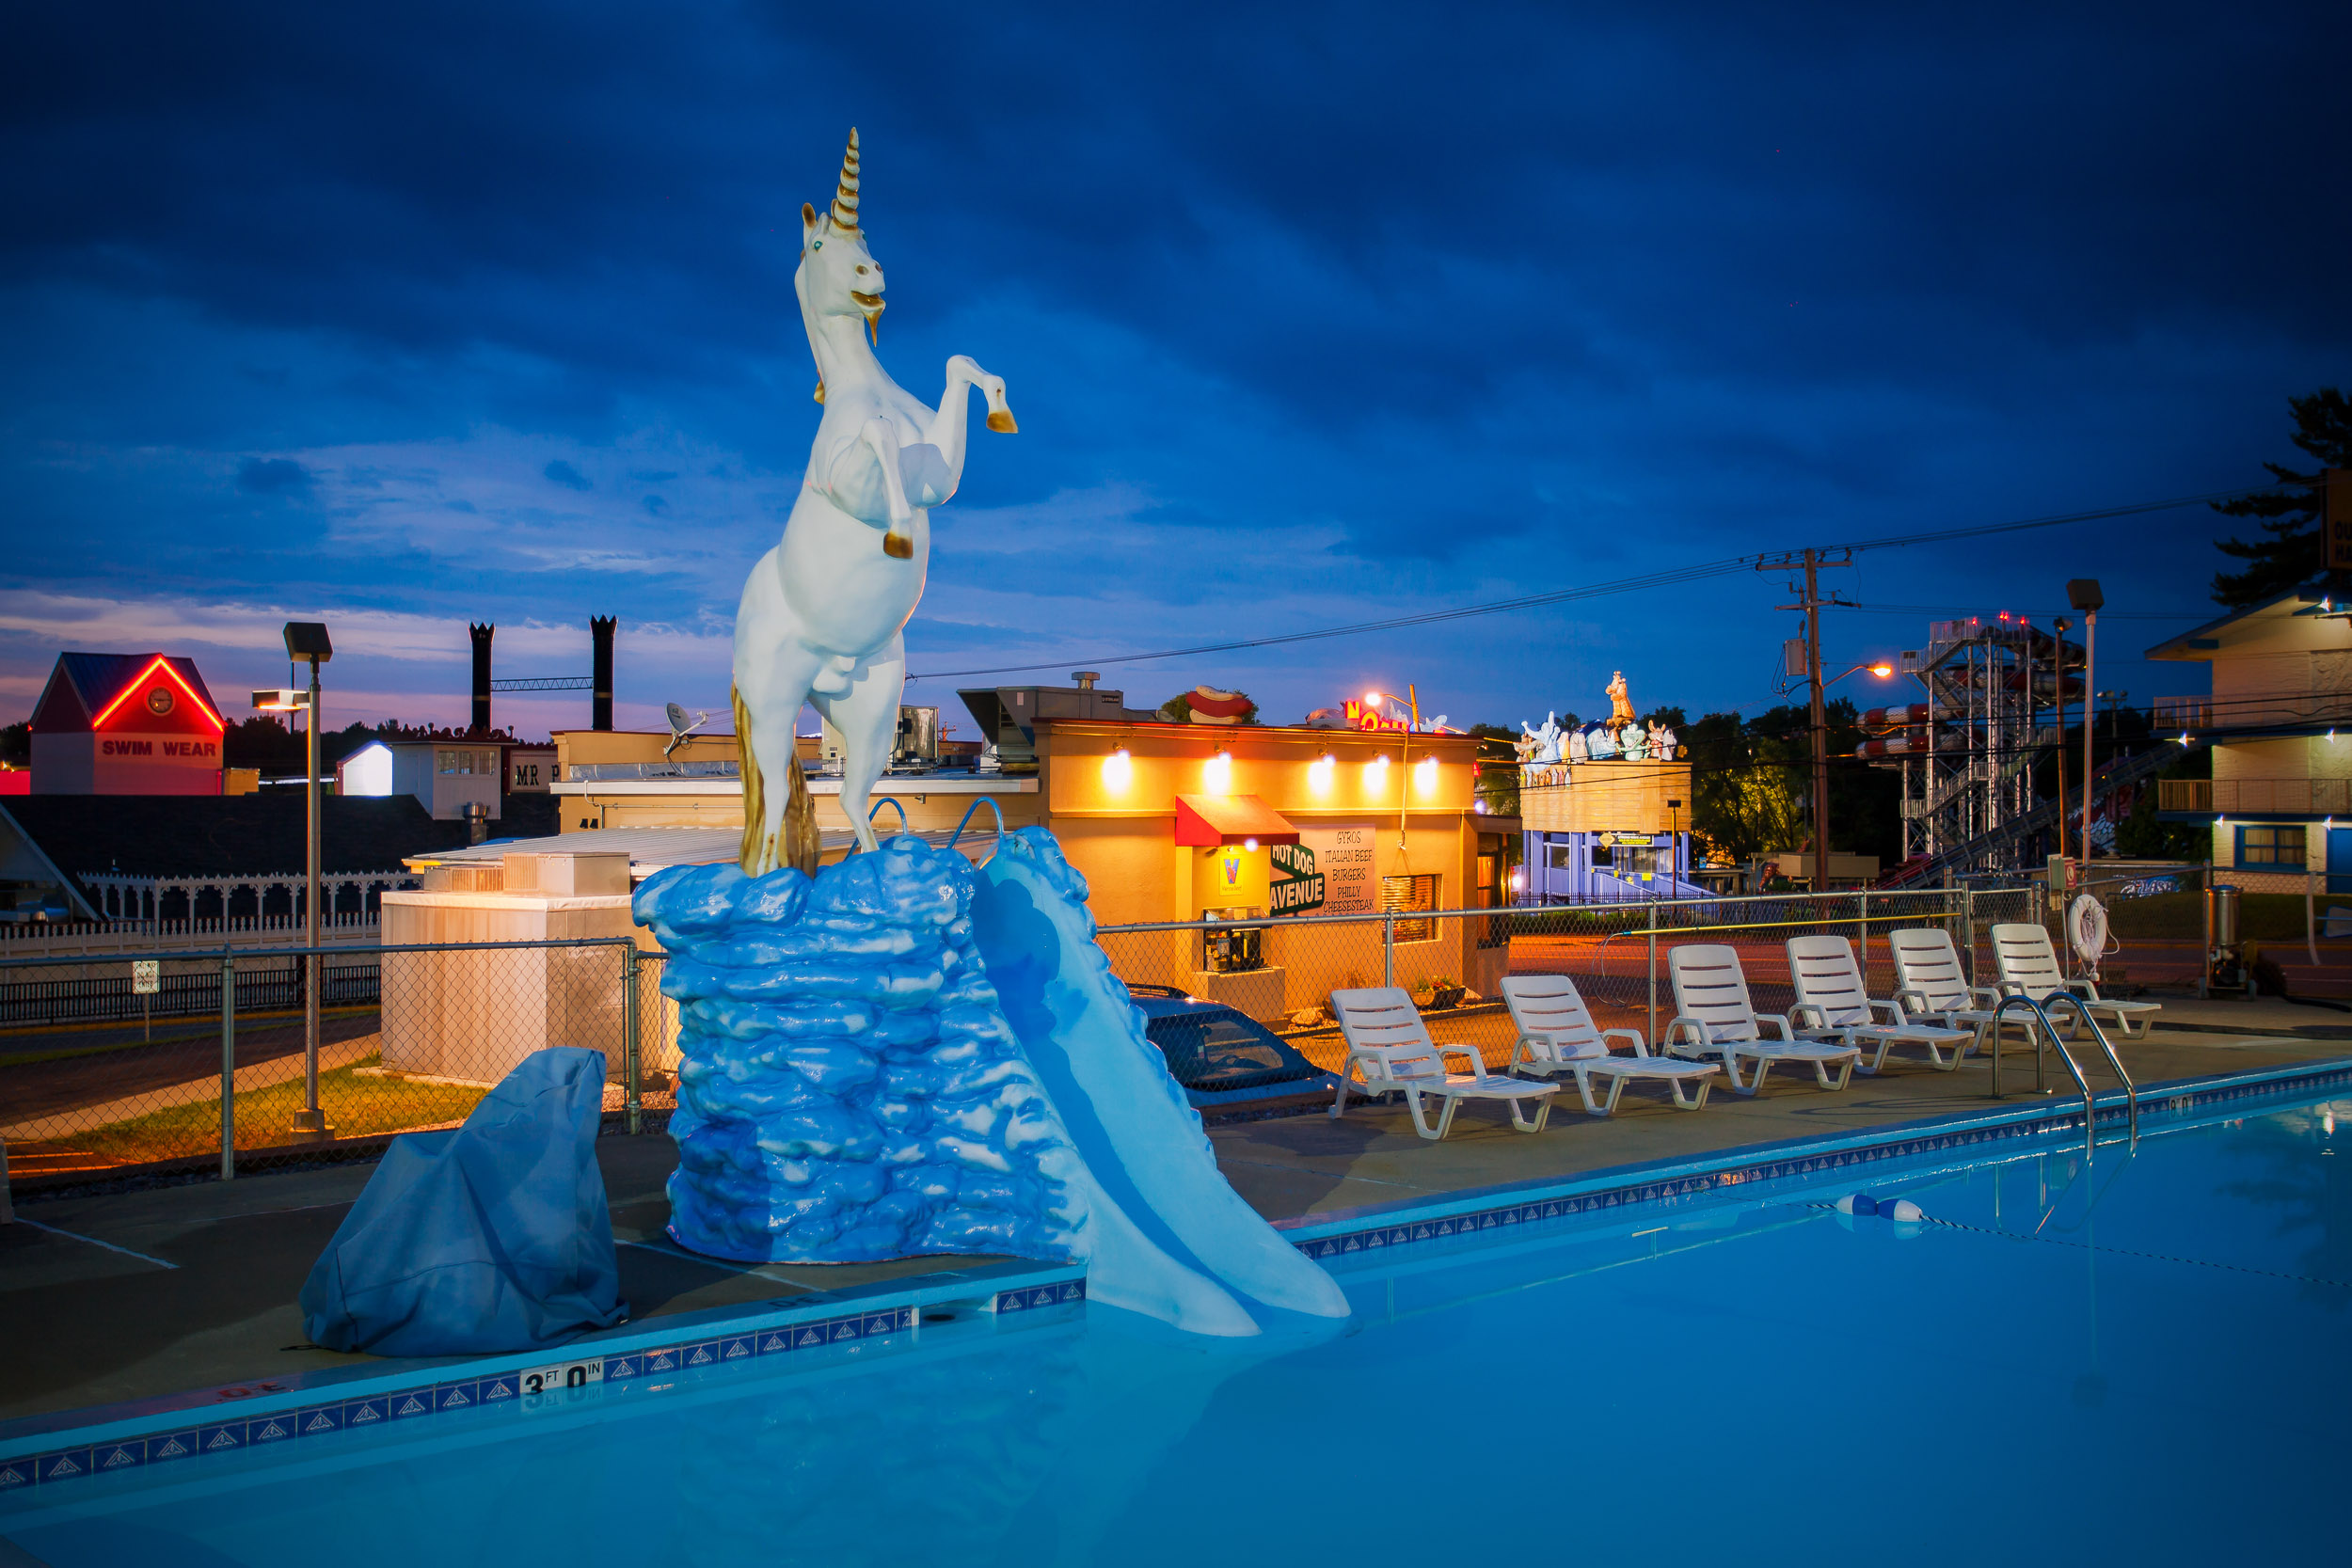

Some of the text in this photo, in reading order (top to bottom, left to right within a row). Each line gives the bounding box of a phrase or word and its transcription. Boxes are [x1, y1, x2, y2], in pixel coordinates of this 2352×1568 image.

[103, 740, 216, 756] SWIM WEAR
[516, 765, 539, 786] MR
[1337, 832, 1361, 845] GYROS
[1272, 844, 1313, 876] HOT DOG
[1325, 849, 1373, 863] ITALIAN BEEF
[1332, 868, 1366, 882] BURGERS
[1270, 878, 1324, 911] AVENUE
[1337, 886, 1361, 899] PHILLY
[1323, 899, 1374, 913] CHEESESTEAK
[525, 1361, 601, 1395] 3 FT 0 IN
